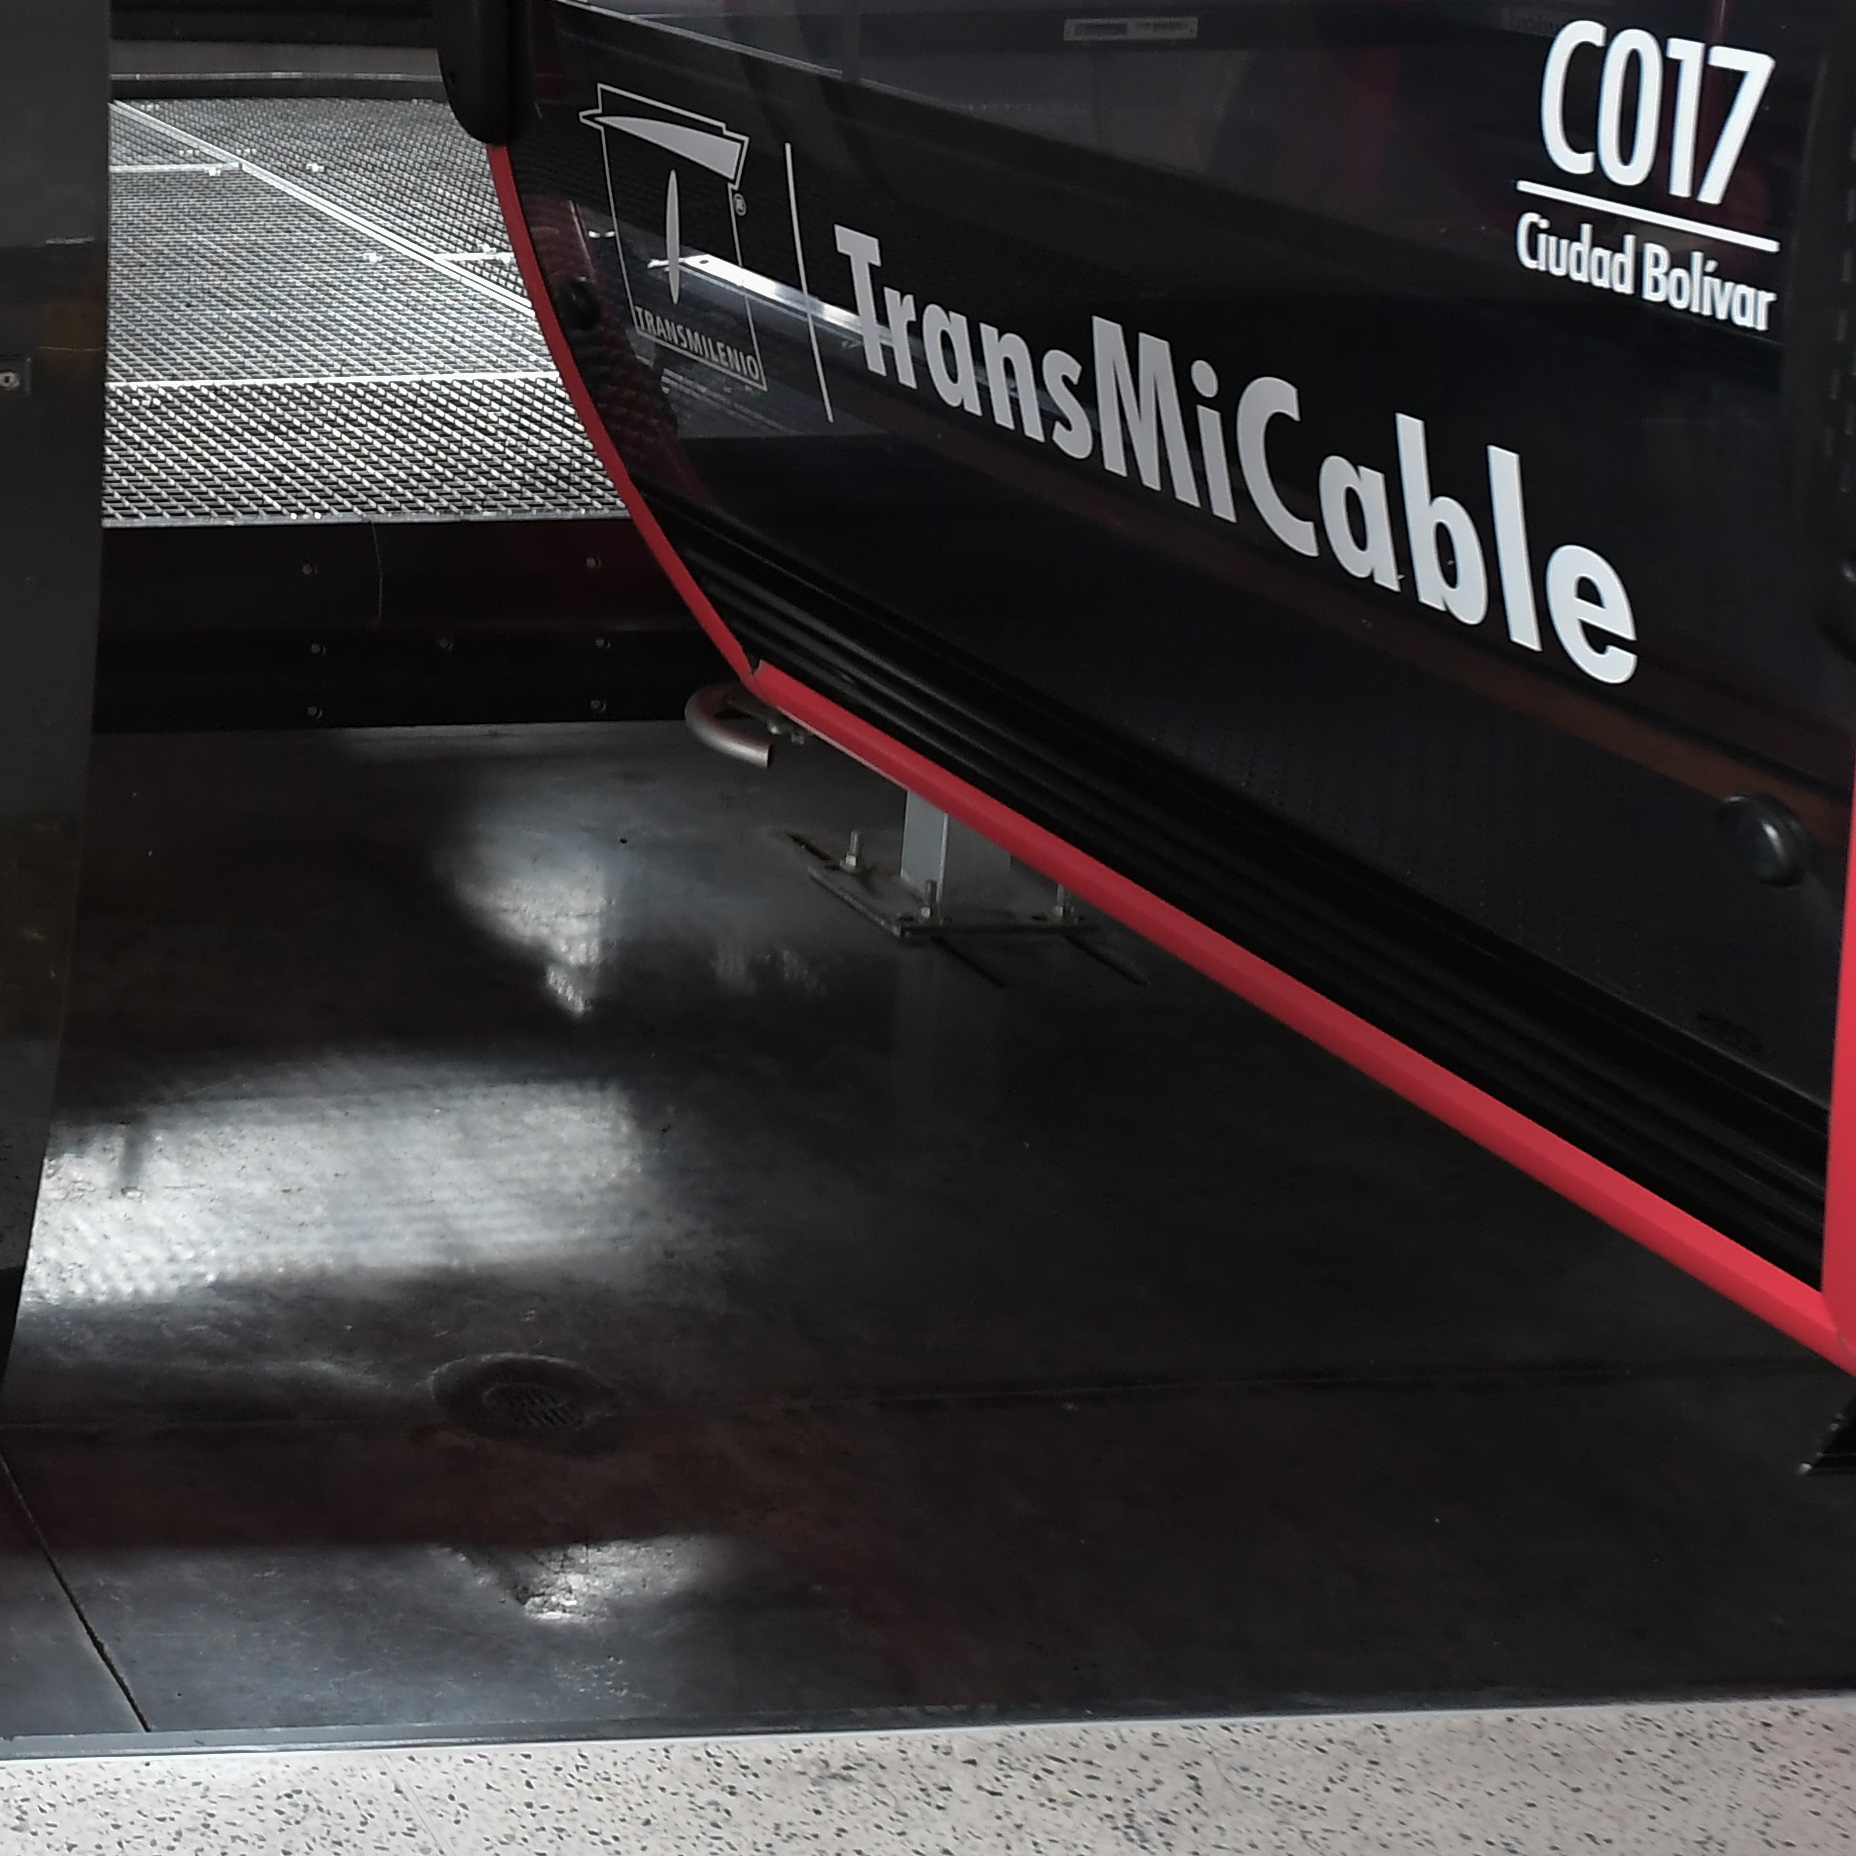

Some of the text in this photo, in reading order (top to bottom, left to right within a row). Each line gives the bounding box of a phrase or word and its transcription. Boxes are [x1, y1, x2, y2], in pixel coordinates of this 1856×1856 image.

[1516, 212, 1777, 331] Ciudad Bolívar
[635, 306, 759, 379] TRANSMILENIO
[834, 224, 1638, 686] TransMiCable
